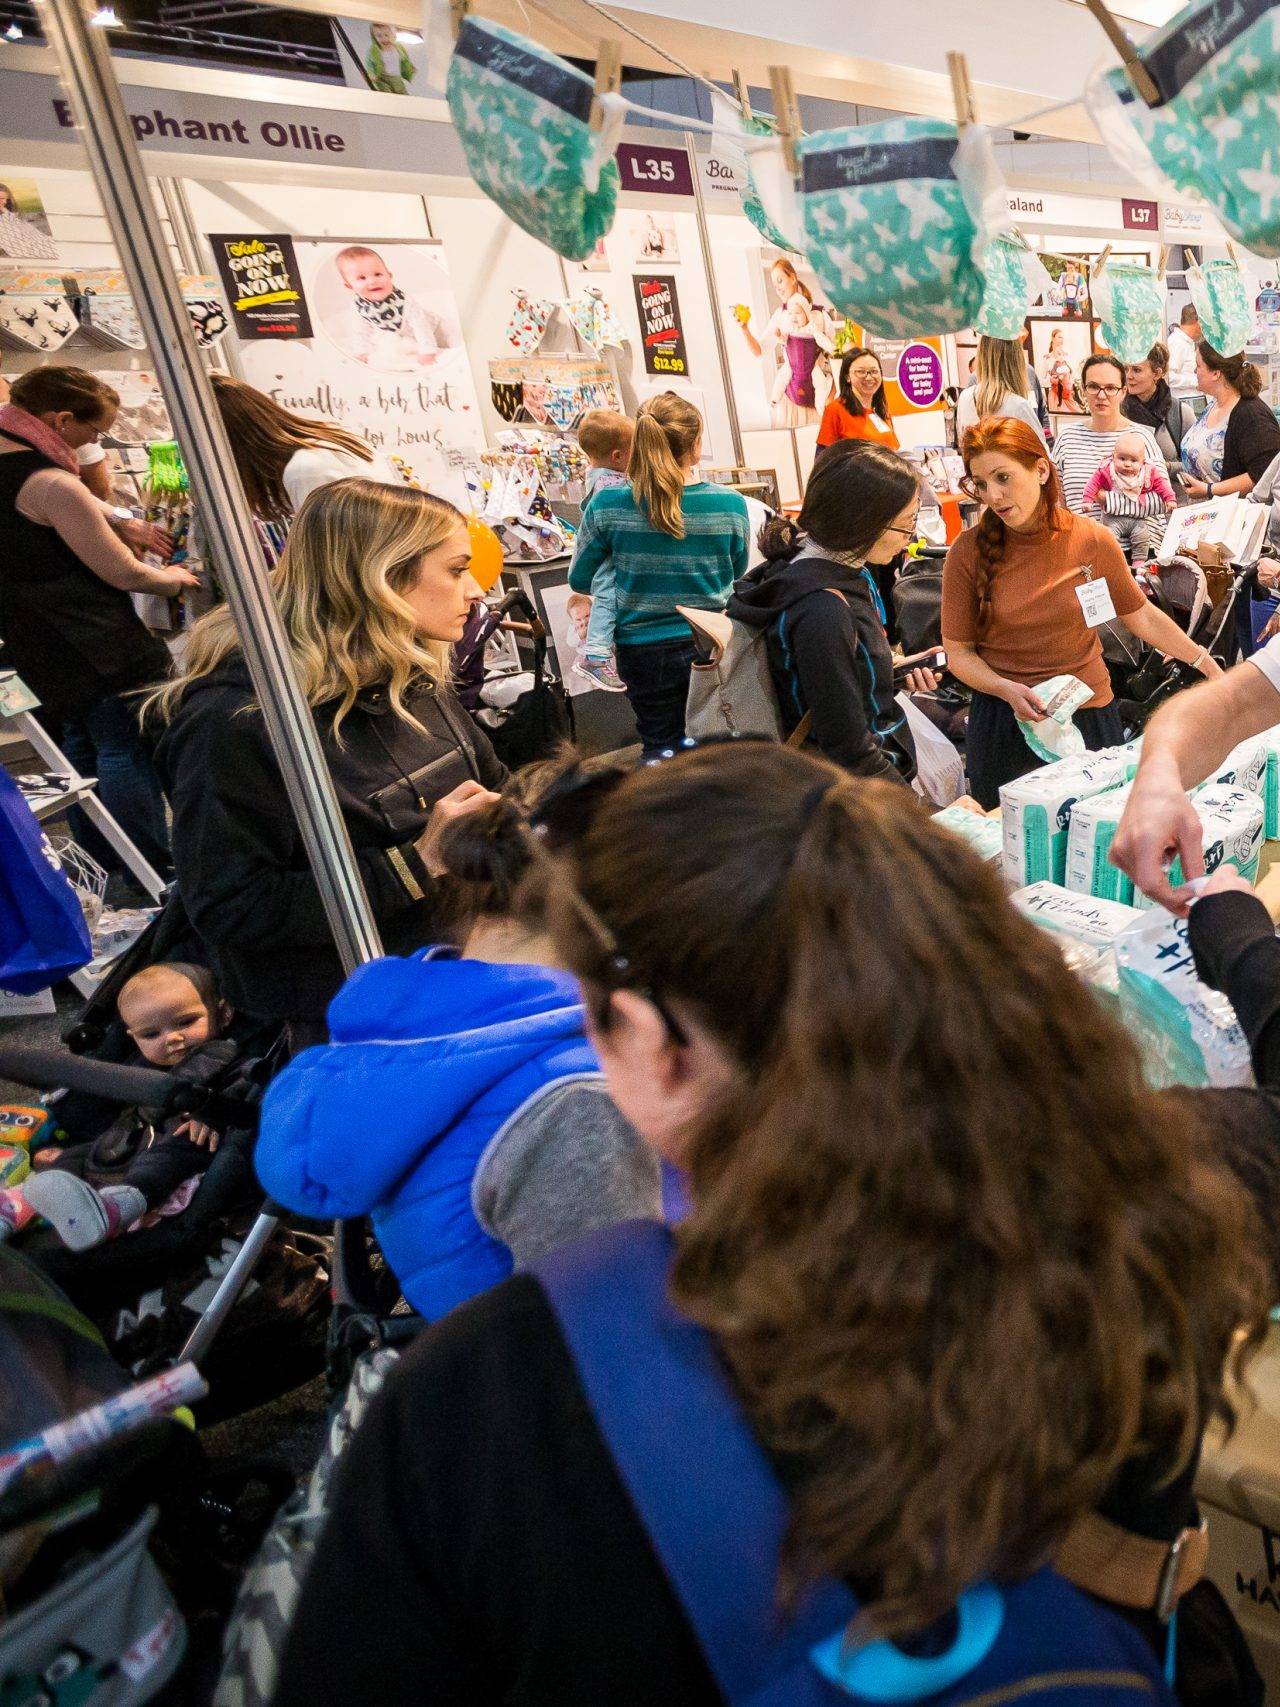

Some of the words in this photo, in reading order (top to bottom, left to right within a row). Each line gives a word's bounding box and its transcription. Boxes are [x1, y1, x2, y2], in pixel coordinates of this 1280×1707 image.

[53, 99, 249, 144] Ephant
[260, 121, 346, 152] Ollie
[630, 157, 675, 182] L35
[1131, 208, 1150, 222] L37
[228, 250, 284, 272] GOING
[246, 265, 272, 280] ON
[236, 274, 292, 298] NOW
[641, 290, 671, 310] GOING
[651, 304, 665, 319] ON
[646, 313, 675, 335] NOW
[653, 356, 685, 373] $12.99
[414, 382, 454, 412] that
